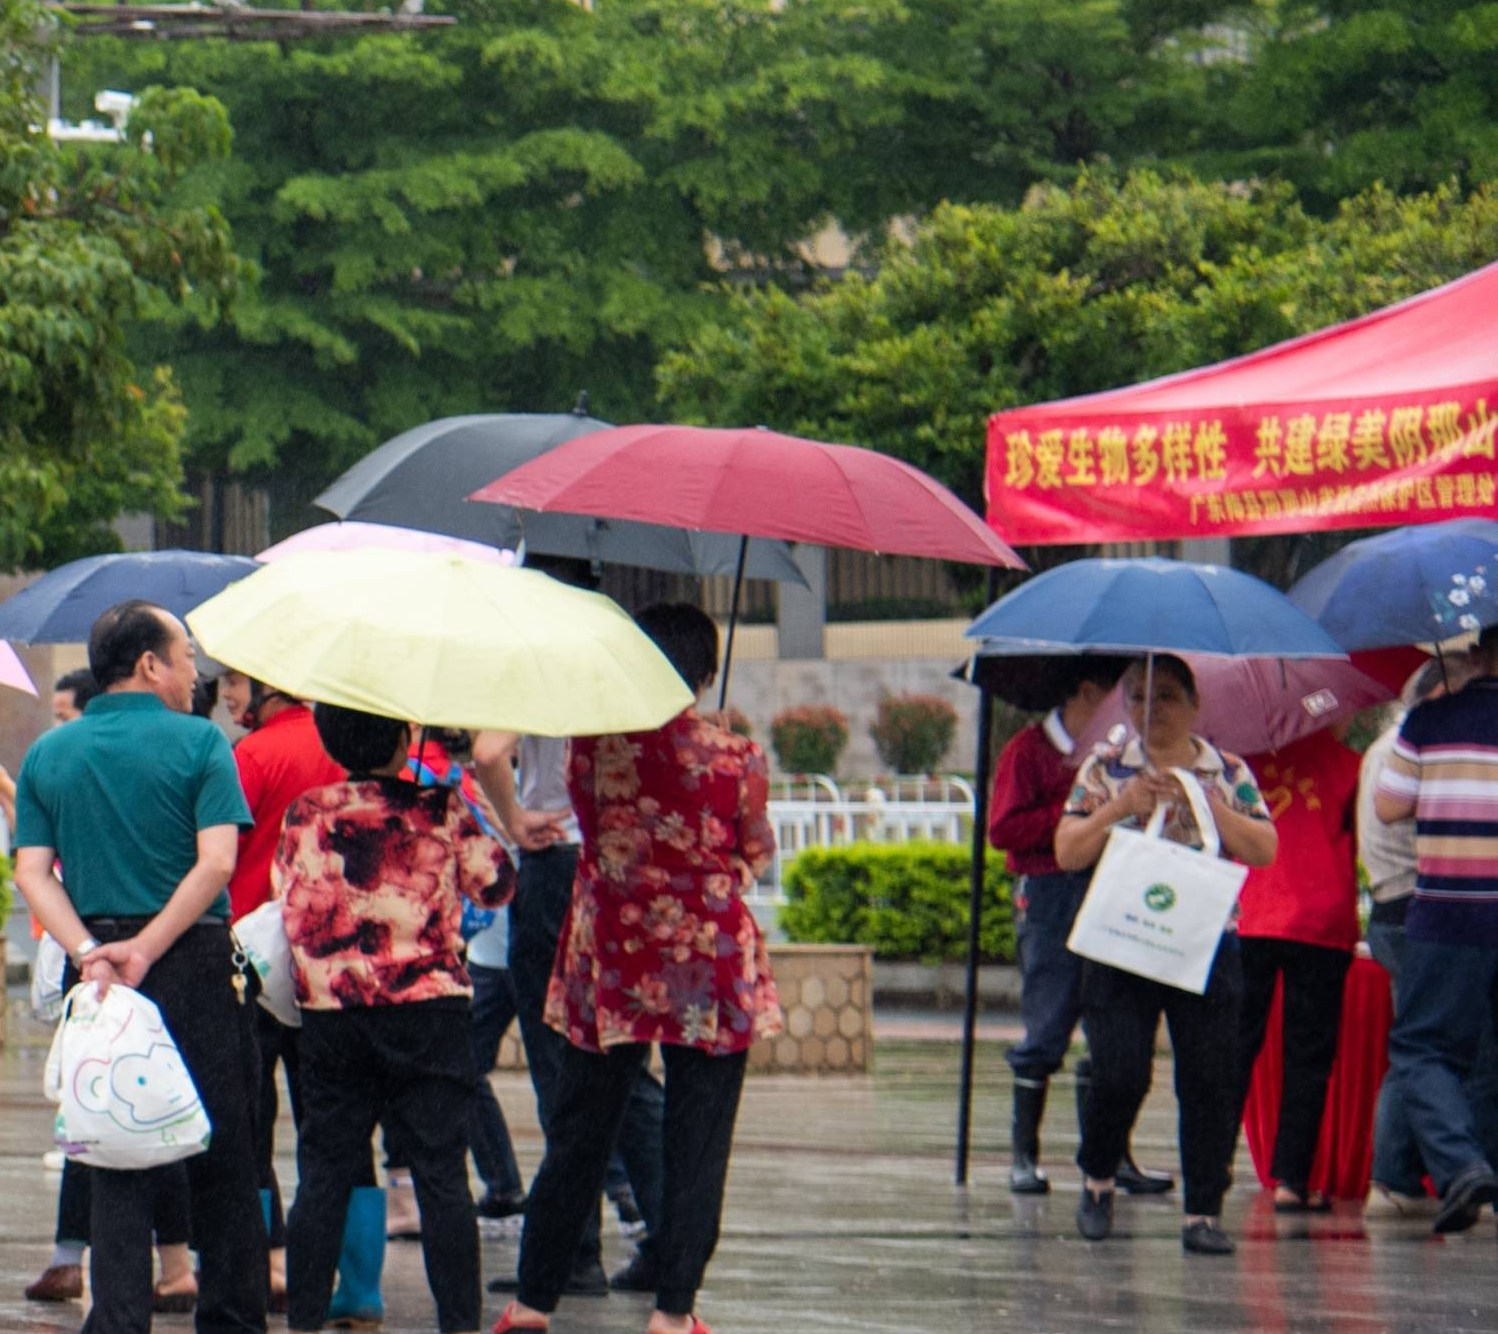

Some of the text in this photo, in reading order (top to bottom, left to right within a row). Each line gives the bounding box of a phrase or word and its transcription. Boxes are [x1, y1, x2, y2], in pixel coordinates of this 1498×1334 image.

[1006, 418, 1228, 491] 珍爱生物多样性
